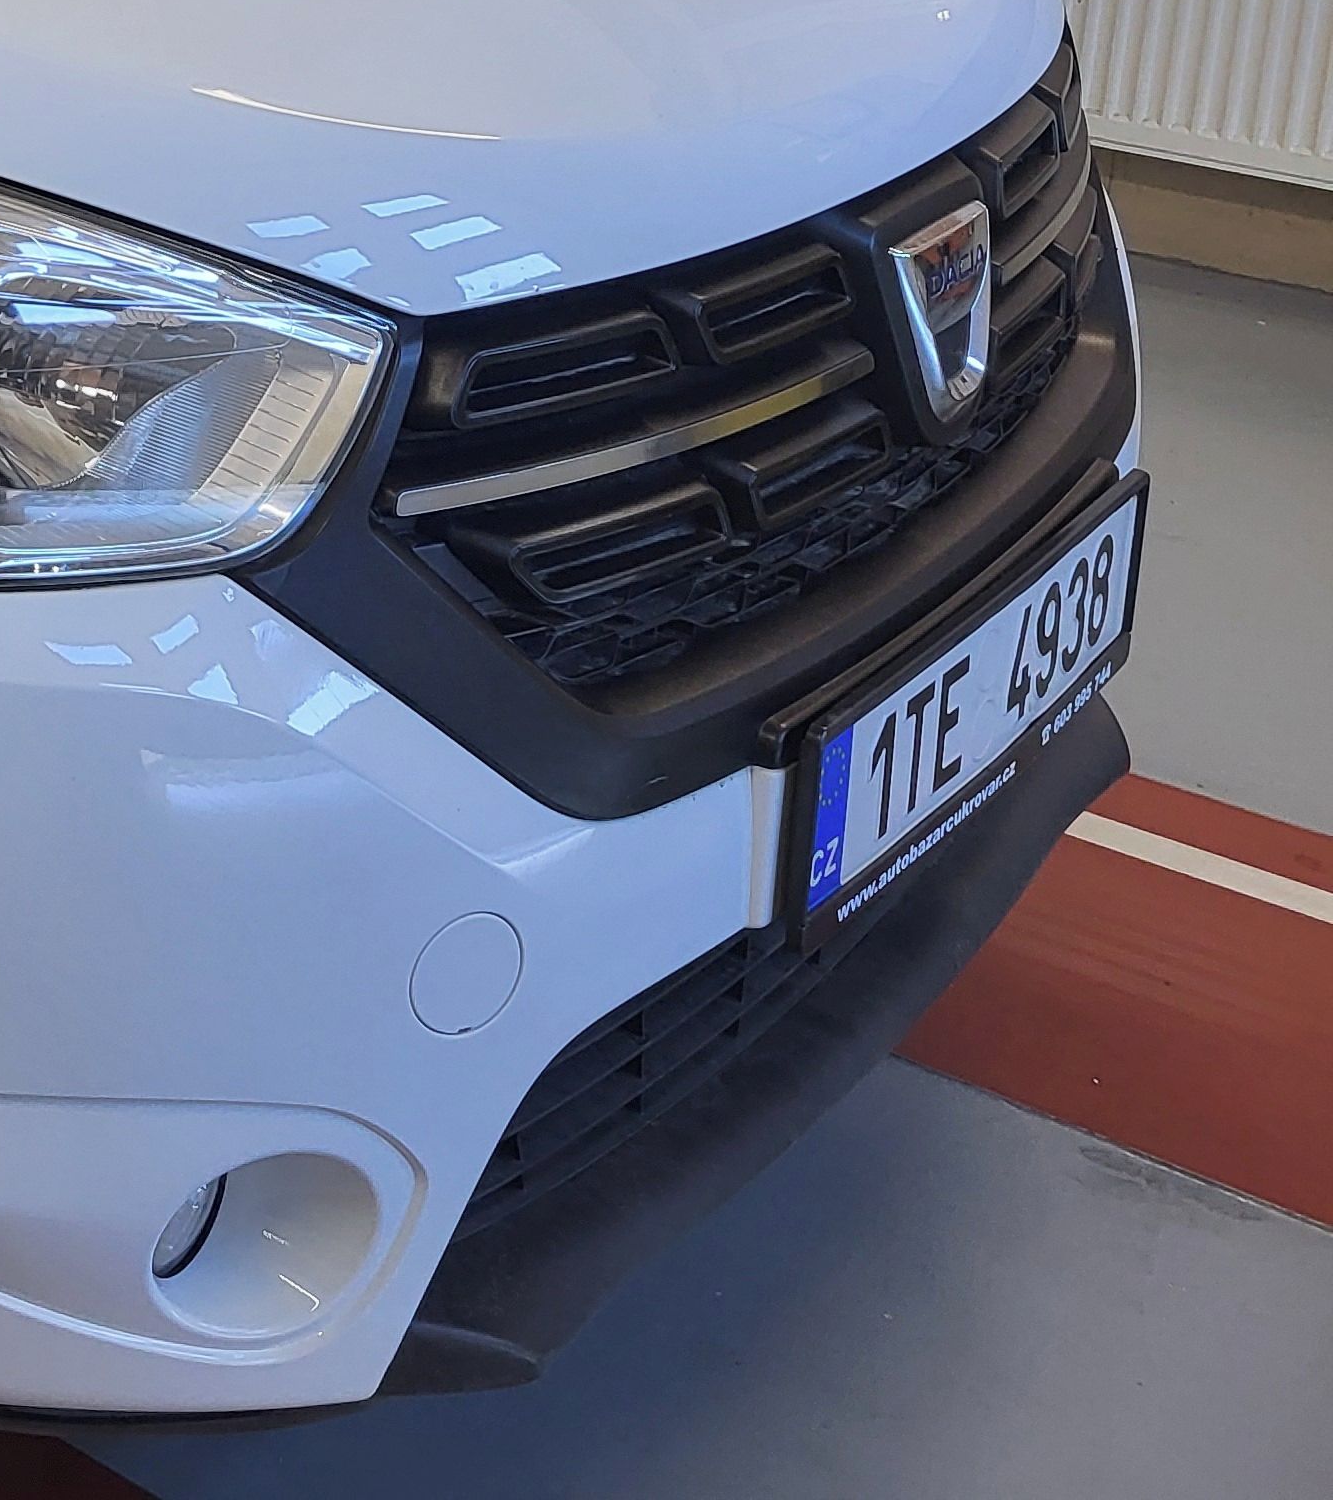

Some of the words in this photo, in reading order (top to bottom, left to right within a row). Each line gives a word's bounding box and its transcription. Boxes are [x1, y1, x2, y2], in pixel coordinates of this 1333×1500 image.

[928, 243, 989, 299] DACIA
[871, 654, 970, 841] 1TE
[1007, 534, 1114, 721] 4938
[1053, 703, 1073, 733] 603
[1073, 683, 1092, 713] 995
[810, 836, 839, 888] CZ
[836, 760, 1017, 922] www.autobazarcukrovar.cz
